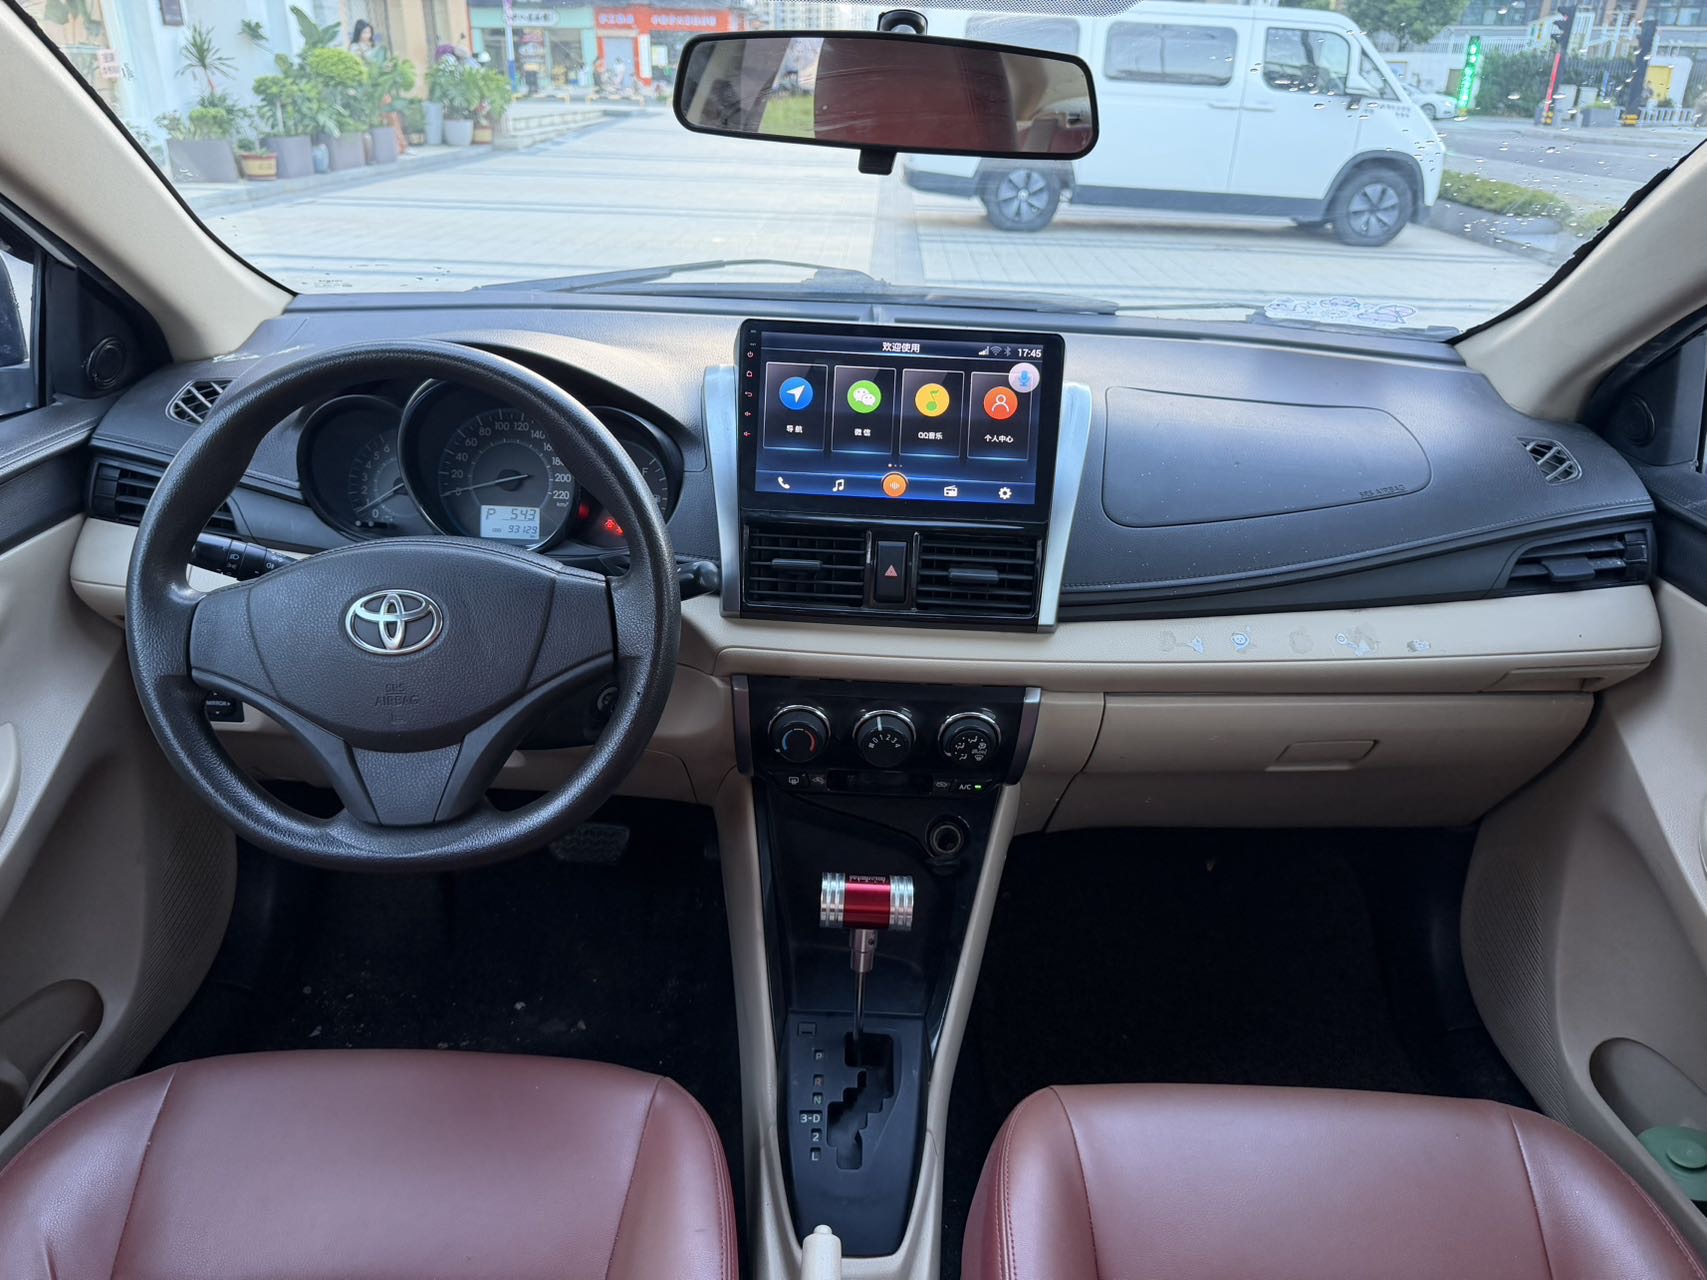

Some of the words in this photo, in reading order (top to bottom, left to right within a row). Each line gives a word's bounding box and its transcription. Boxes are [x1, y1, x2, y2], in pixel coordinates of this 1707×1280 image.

[882, 341, 920, 353] 欢迎使用
[1017, 348, 1042, 358] 17:45
[495, 421, 510, 431] 100
[514, 421, 529, 431] 120
[786, 425, 803, 434] 导航
[478, 427, 491, 436] 80
[854, 428, 871, 437] 微信
[918, 431, 943, 441] QQ音乐
[465, 437, 478, 447] 60
[984, 434, 1014, 444] 个人中心
[543, 442, 553, 451] 16
[456, 452, 468, 461] 40
[552, 456, 563, 466] 18
[451, 469, 463, 478] 20
[642, 467, 648, 475] F
[554, 473, 571, 482] 200
[361, 485, 368, 495] 2
[553, 490, 570, 499] 220
[371, 508, 379, 518] 0
[486, 508, 496, 520] P
[511, 508, 537, 520] 543
[508, 524, 538, 535] 93129
[816, 1052, 823, 1060] P
[814, 1077, 822, 1086] R
[813, 1096, 821, 1104] N
[800, 1114, 820, 1123] 3-D
[812, 1133, 819, 1142] 2
[811, 1152, 818, 1161] L
